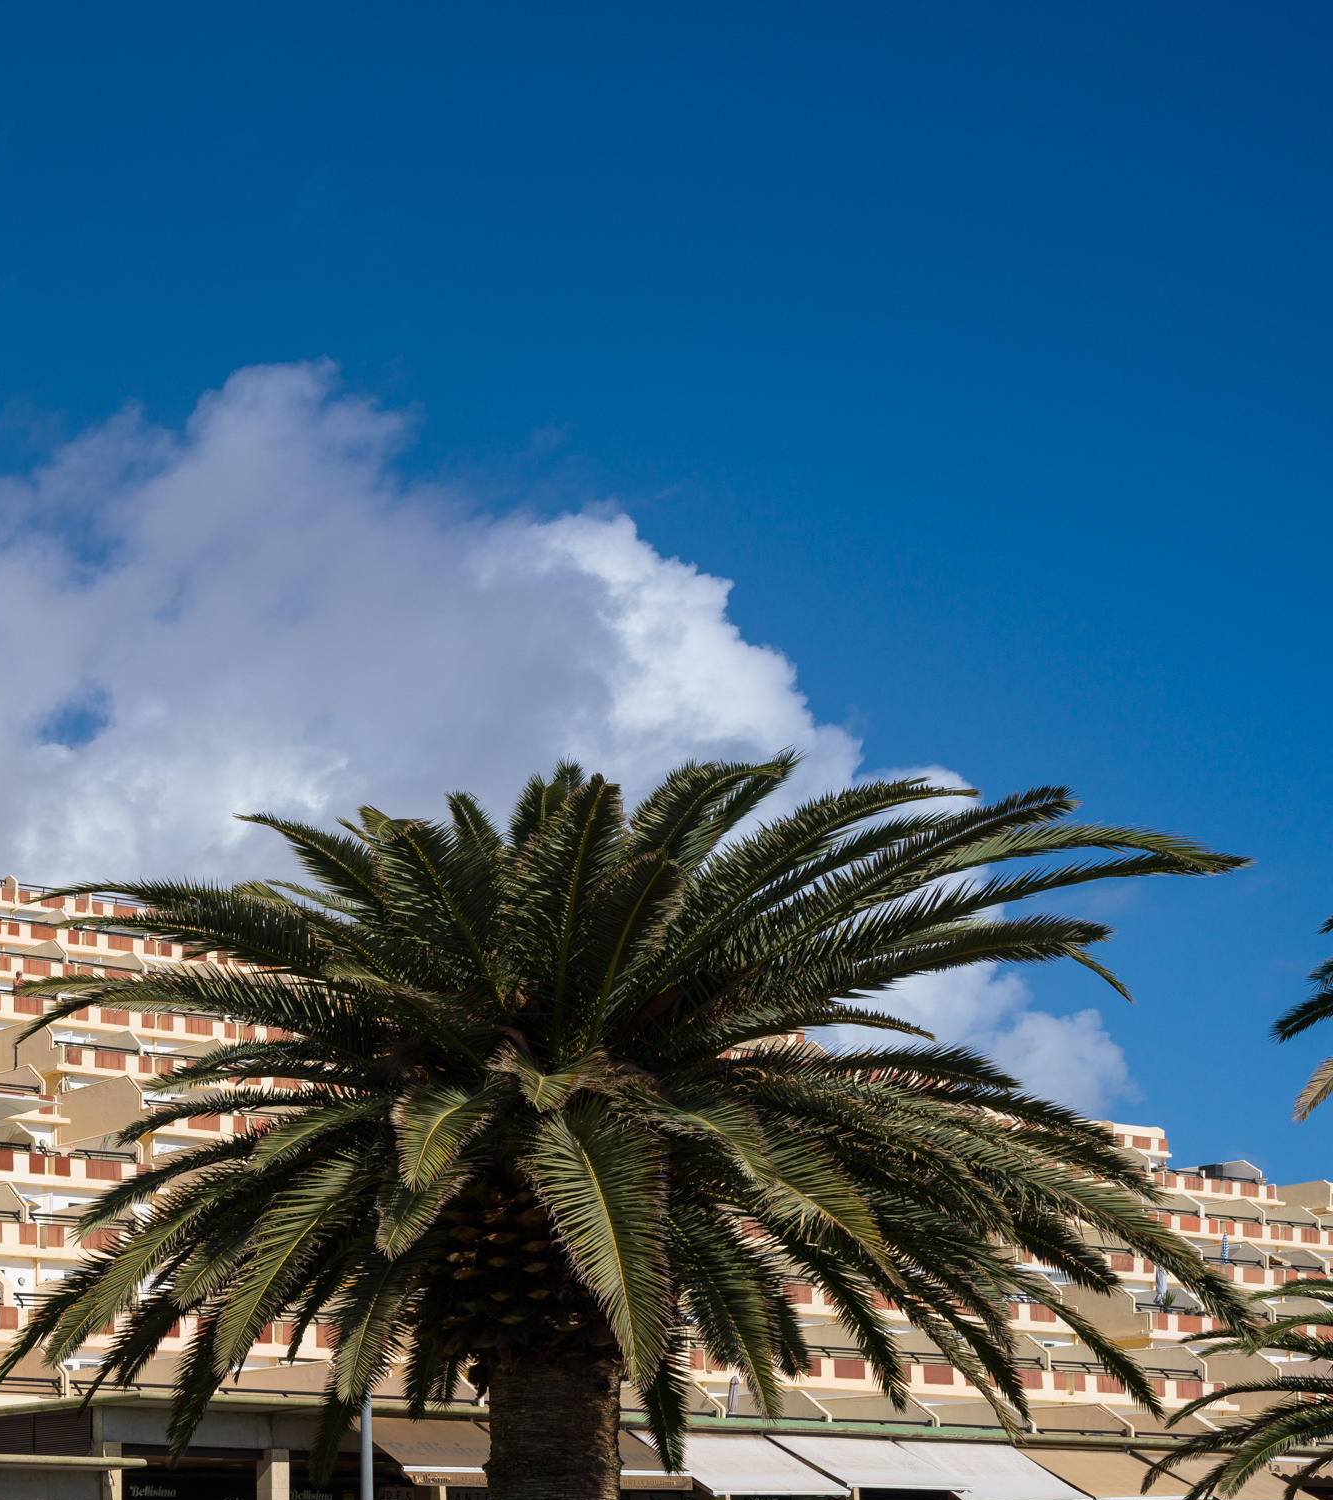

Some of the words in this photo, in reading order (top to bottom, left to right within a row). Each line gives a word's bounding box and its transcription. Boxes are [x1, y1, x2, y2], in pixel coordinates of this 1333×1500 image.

[410, 1473, 451, 1484] Bellisima
[129, 1484, 177, 1498] Bellisima
[290, 1489, 333, 1500] Bellisima
